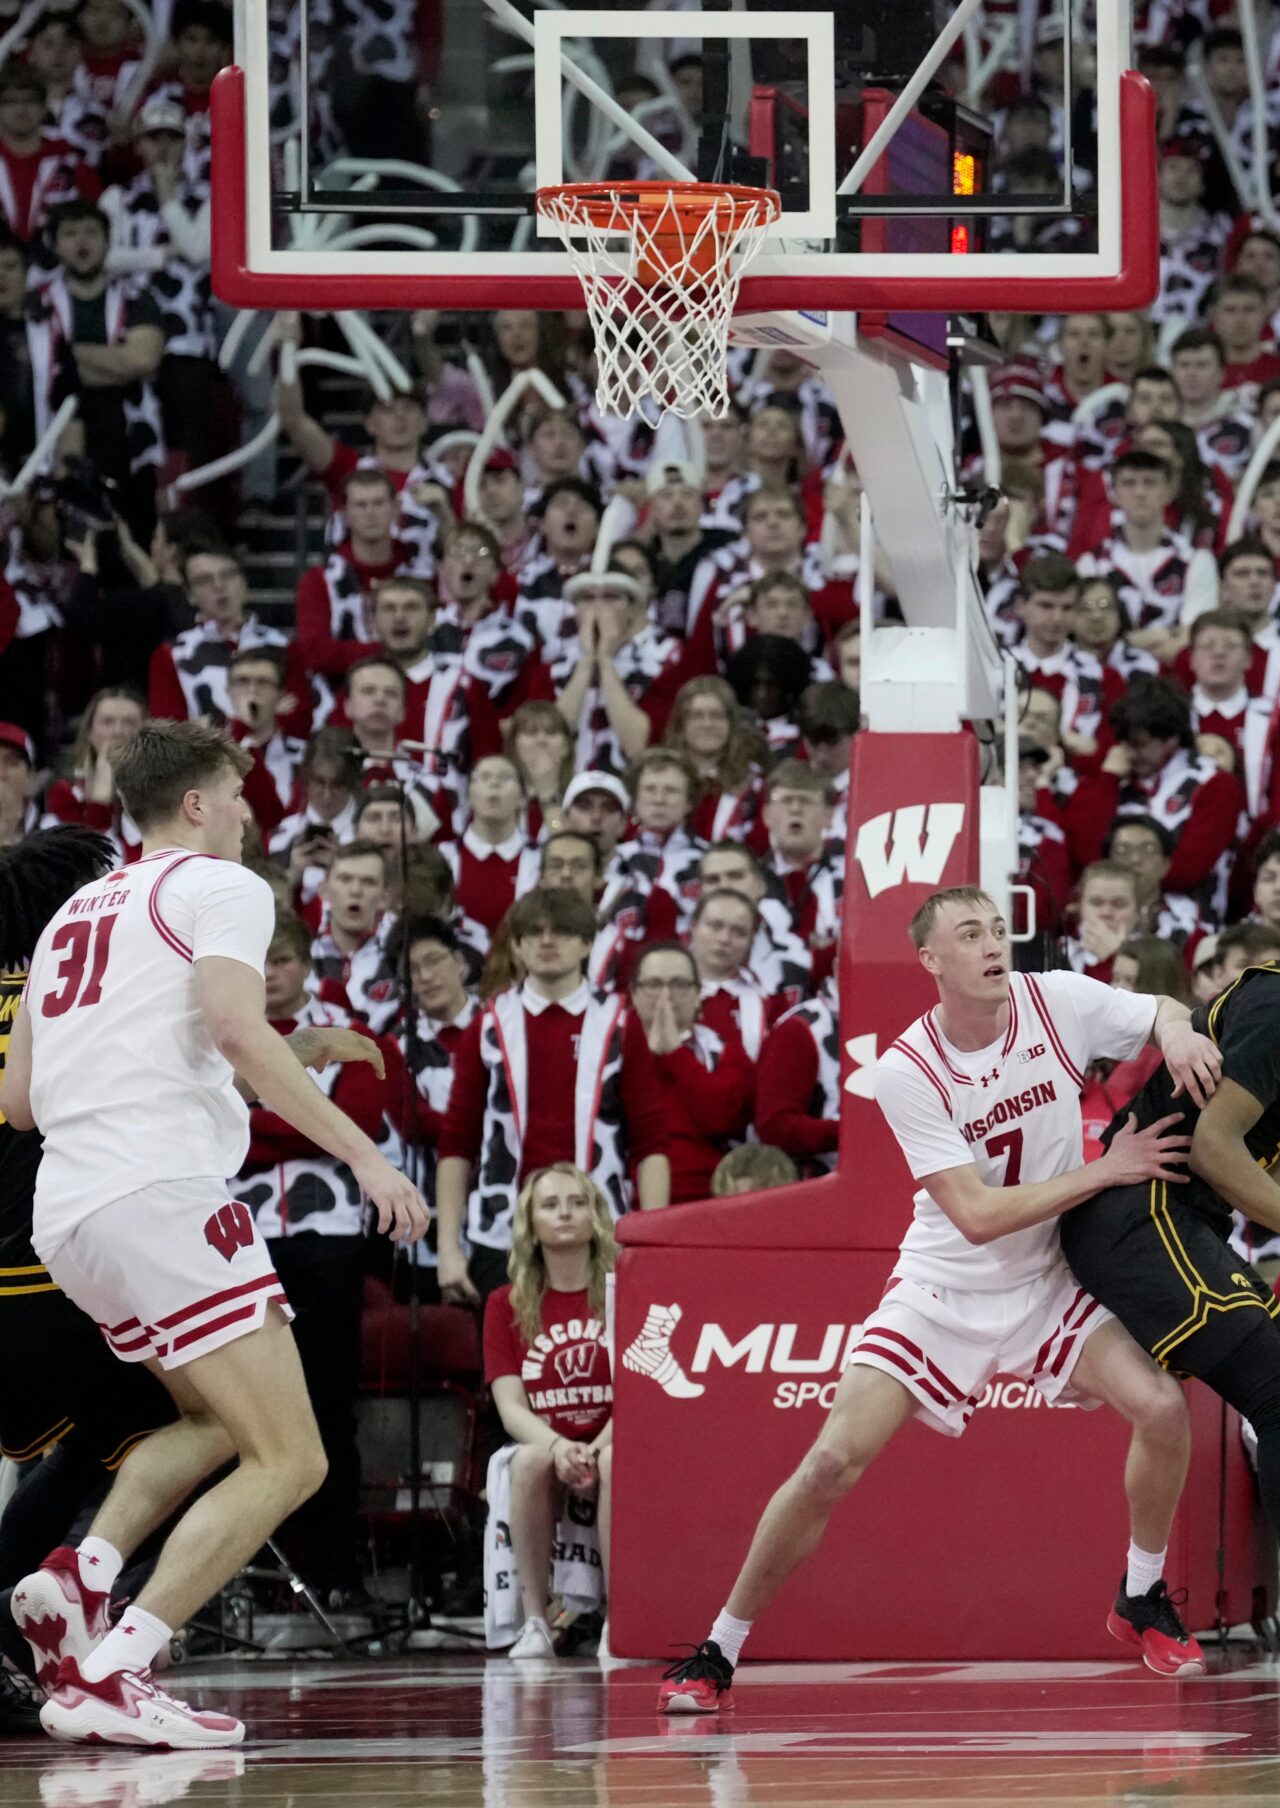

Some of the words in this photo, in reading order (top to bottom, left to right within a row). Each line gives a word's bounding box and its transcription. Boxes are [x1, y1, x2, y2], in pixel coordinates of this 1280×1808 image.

[854, 803, 965, 900] W
[68, 890, 131, 915] WINTER
[41, 913, 119, 1018] 31
[985, 1127, 1024, 1187] 7
[203, 1201, 254, 1264] W
[554, 1341, 598, 1385] W
[528, 1384, 613, 1410] ASKETBA
